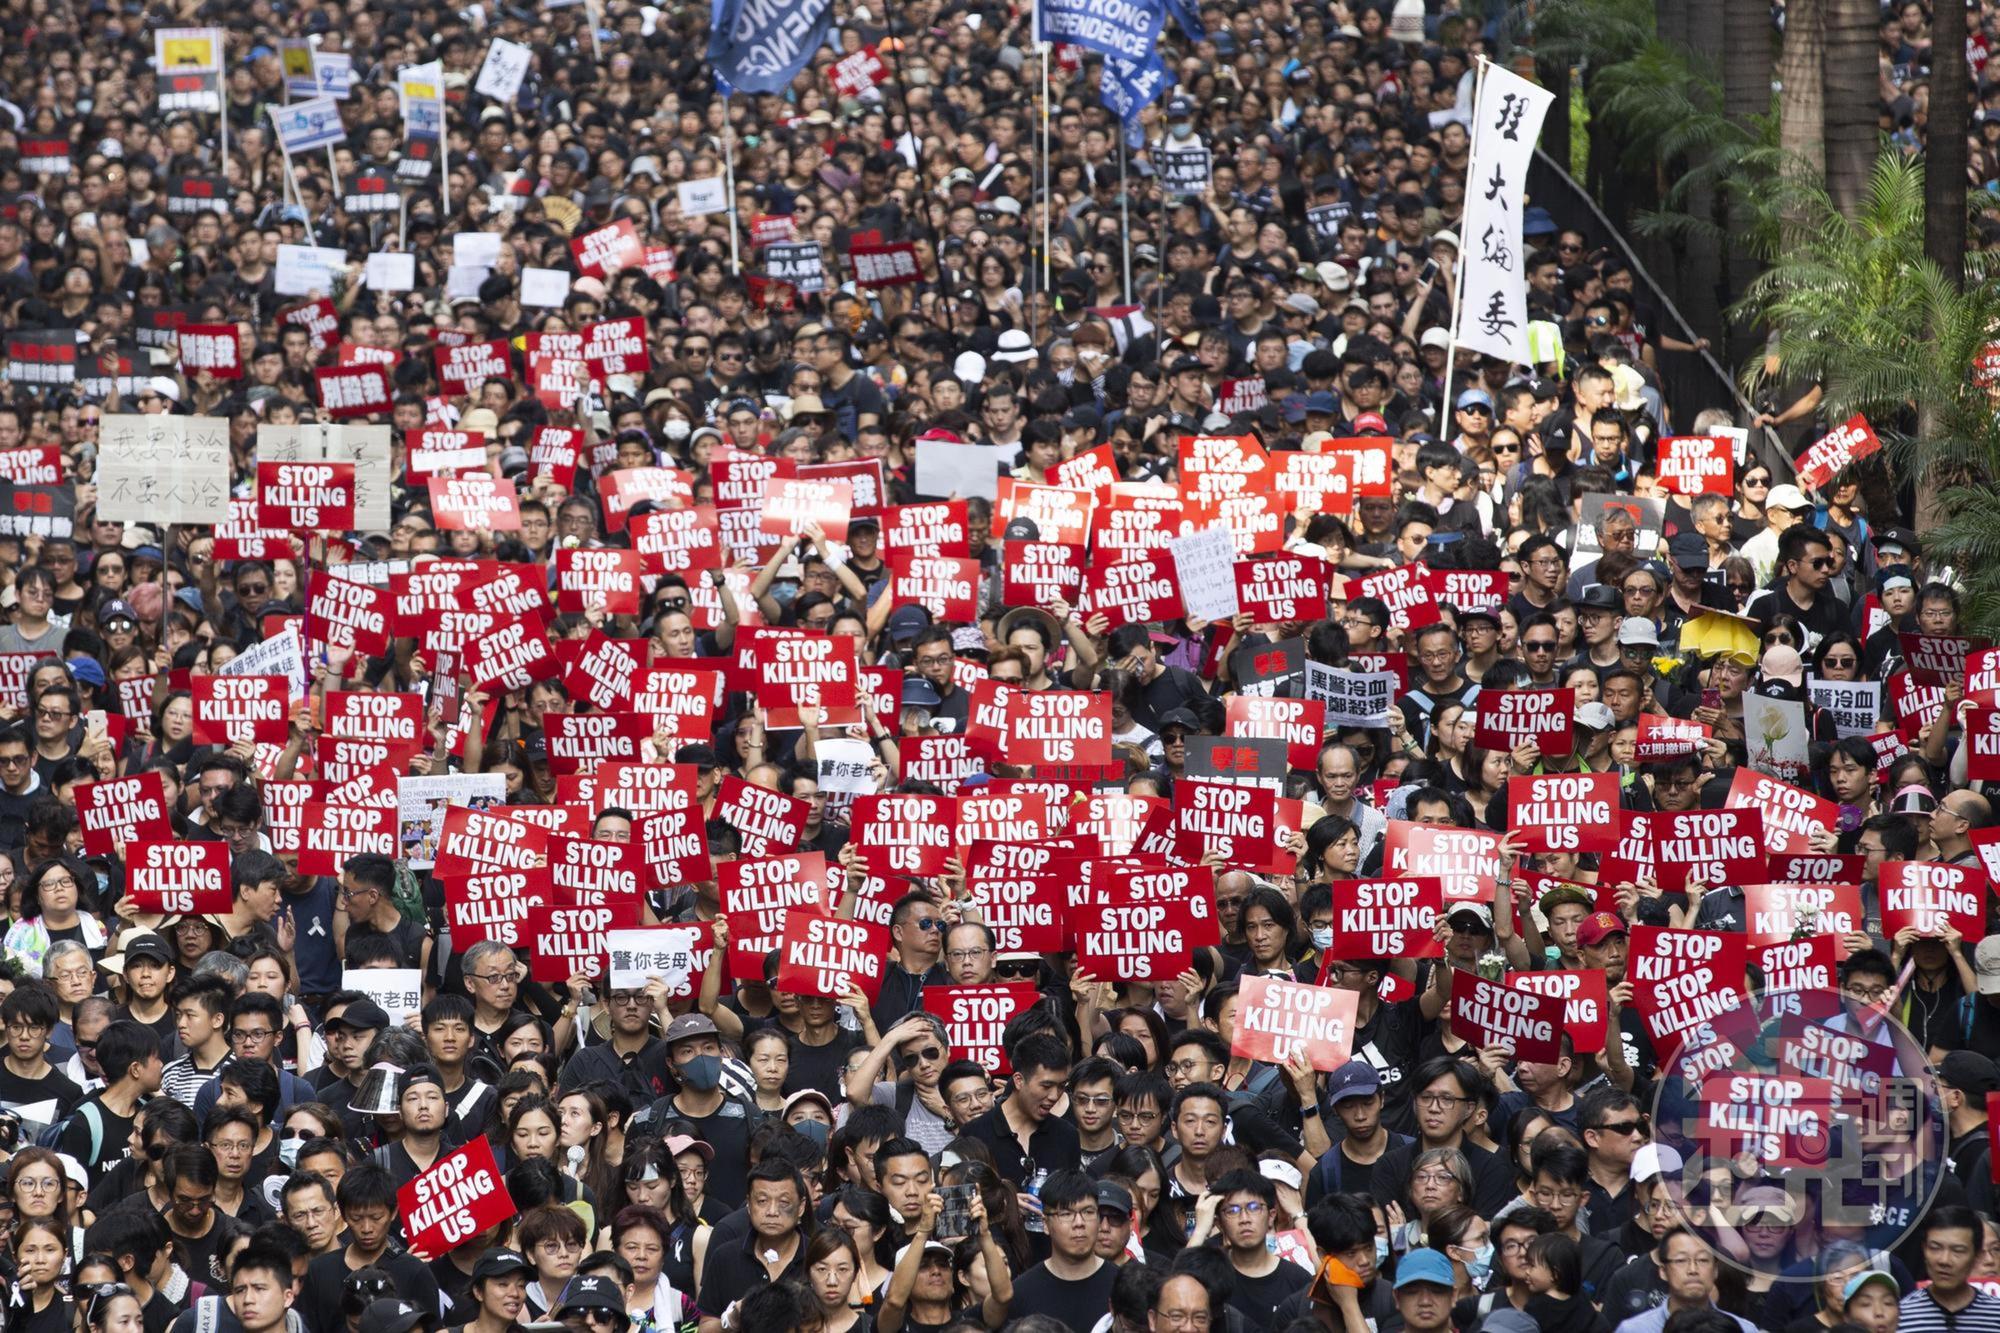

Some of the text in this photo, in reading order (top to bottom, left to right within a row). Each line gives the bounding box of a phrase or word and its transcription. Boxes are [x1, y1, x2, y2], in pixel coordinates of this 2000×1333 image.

[593, 322, 630, 341] STOP
[540, 335, 582, 350] STOP
[585, 337, 642, 359] KILLING
[450, 345, 492, 362] STOP
[442, 359, 506, 380] KILLING
[603, 356, 625, 373] US
[112, 429, 224, 463] 我要法治
[423, 432, 467, 449] STOP
[539, 429, 572, 445] STOP
[531, 448, 575, 465] KILLING
[1671, 439, 1714, 458] STOP
[729, 462, 776, 480] STOP
[1288, 455, 1336, 473] STOP
[1661, 457, 1726, 476] KILLING
[277, 466, 333, 486] STOP
[1197, 474, 1247, 491] STOP
[1276, 473, 1347, 493] KILLING
[1679, 476, 1703, 494] US
[110, 477, 222, 508] 不要人治
[264, 486, 347, 507] KILLING
[447, 480, 496, 496] STOP
[784, 483, 833, 499] STOP
[1030, 490, 1076, 507] STOP
[437, 496, 512, 512] KILLING
[770, 499, 844, 516] KILLING
[1220, 496, 1267, 517] STOP
[1297, 493, 1322, 511] US
[290, 508, 319, 527] US
[464, 512, 489, 528] US
[900, 506, 949, 526] STOP
[1111, 510, 1160, 529] STOP
[637, 528, 712, 554] KILLING
[889, 524, 963, 547] KILLING
[1099, 530, 1172, 548] KILLING
[238, 540, 264, 558] US
[1024, 545, 1071, 564] STOP
[571, 552, 621, 570] STOP
[663, 550, 690, 570] US
[910, 558, 960, 579] STOP
[561, 571, 632, 592] KILLING
[1011, 564, 1080, 584] KILLING
[1253, 562, 1302, 581] STOP
[897, 577, 971, 602] KILLING
[1036, 585, 1061, 603] US
[1095, 580, 1172, 608] KILLING
[1242, 582, 1317, 602] KILLING
[1446, 574, 1492, 593] STOP
[311, 596, 384, 633] KILLING
[1123, 603, 1150, 622] US
[1269, 601, 1296, 619] US
[440, 612, 493, 633] STOP
[776, 640, 833, 662] STOP
[1919, 637, 1970, 655] STOP
[473, 638, 547, 684] KILLING
[646, 672, 696, 693] STOP
[763, 661, 847, 684] KILLING
[1311, 669, 1387, 697] 黑警冷血
[213, 679, 268, 700] STOP
[1806, 689, 1874, 709] 警冷血
[200, 700, 281, 720] KILLING
[346, 696, 401, 716] STOP
[634, 693, 706, 717] KILLING
[1030, 695, 1089, 717] STOP
[1248, 701, 1303, 722] STOP
[1499, 693, 1554, 713] STOP
[332, 716, 415, 738] KILLING
[563, 717, 616, 737] STOP
[1015, 717, 1104, 740] KILLING
[1484, 712, 1565, 733] KILLING
[552, 737, 633, 757] KILLING
[1043, 740, 1074, 762] US
[619, 767, 675, 788] STOP
[92, 779, 142, 807] STOP
[264, 784, 312, 805] STOP
[604, 789, 688, 810] KILLING
[1194, 786, 1251, 813] STOP
[1532, 778, 1594, 801] STOP
[1755, 779, 1817, 813] STOP
[84, 799, 160, 830] KILLING
[323, 808, 382, 831] STOP
[877, 799, 936, 822] STOP
[962, 798, 1023, 822] STOP
[1089, 799, 1148, 820] STOP
[1516, 802, 1610, 826] KILLING
[466, 814, 526, 844] STOP
[720, 802, 796, 845] KILLING
[1181, 808, 1264, 839] KILLING
[1674, 814, 1737, 838] STOP
[272, 829, 299, 850] US
[307, 828, 393, 855] KILLING
[863, 823, 949, 847] KILLING
[1433, 835, 1495, 855] STOP
[1546, 826, 1579, 849] US
[147, 845, 206, 868] STOP
[447, 833, 536, 870] KILLING
[889, 846, 921, 870] US
[1661, 837, 1756, 863] KILLING
[553, 863, 636, 894] KILLING
[1787, 858, 1843, 879] STOP
[1902, 865, 1964, 889] STOP
[133, 869, 222, 891] KILLING
[467, 874, 526, 900] STOP
[1446, 876, 1479, 896] US
[161, 892, 194, 912] US
[727, 881, 819, 913] KILLING
[1357, 883, 1419, 907] STOP
[1771, 889, 1835, 910] STOP
[1888, 889, 1978, 916] KILLING
[1101, 906, 1165, 931] STOP
[1342, 906, 1435, 932] KILLING
[1086, 931, 1183, 956] KILLING
[1372, 932, 1404, 955] US
[612, 950, 688, 970] 警你老母
[789, 941, 879, 978] KILLING
[1117, 956, 1152, 978] US
[365, 990, 419, 1009] 你老母
[1264, 984, 1331, 1014] STOP
[1475, 982, 1539, 1016] STOP
[952, 998, 1016, 1022] STOP
[1458, 997, 1552, 1042] KILLING
[1649, 987, 1741, 1039] KILLING
[1244, 1006, 1344, 1043] KILLING
[1709, 1102, 1819, 1137] KILLING
[415, 1153, 468, 1204] STOP
[409, 1169, 495, 1237] KILLING
[439, 1208, 477, 1244] US
